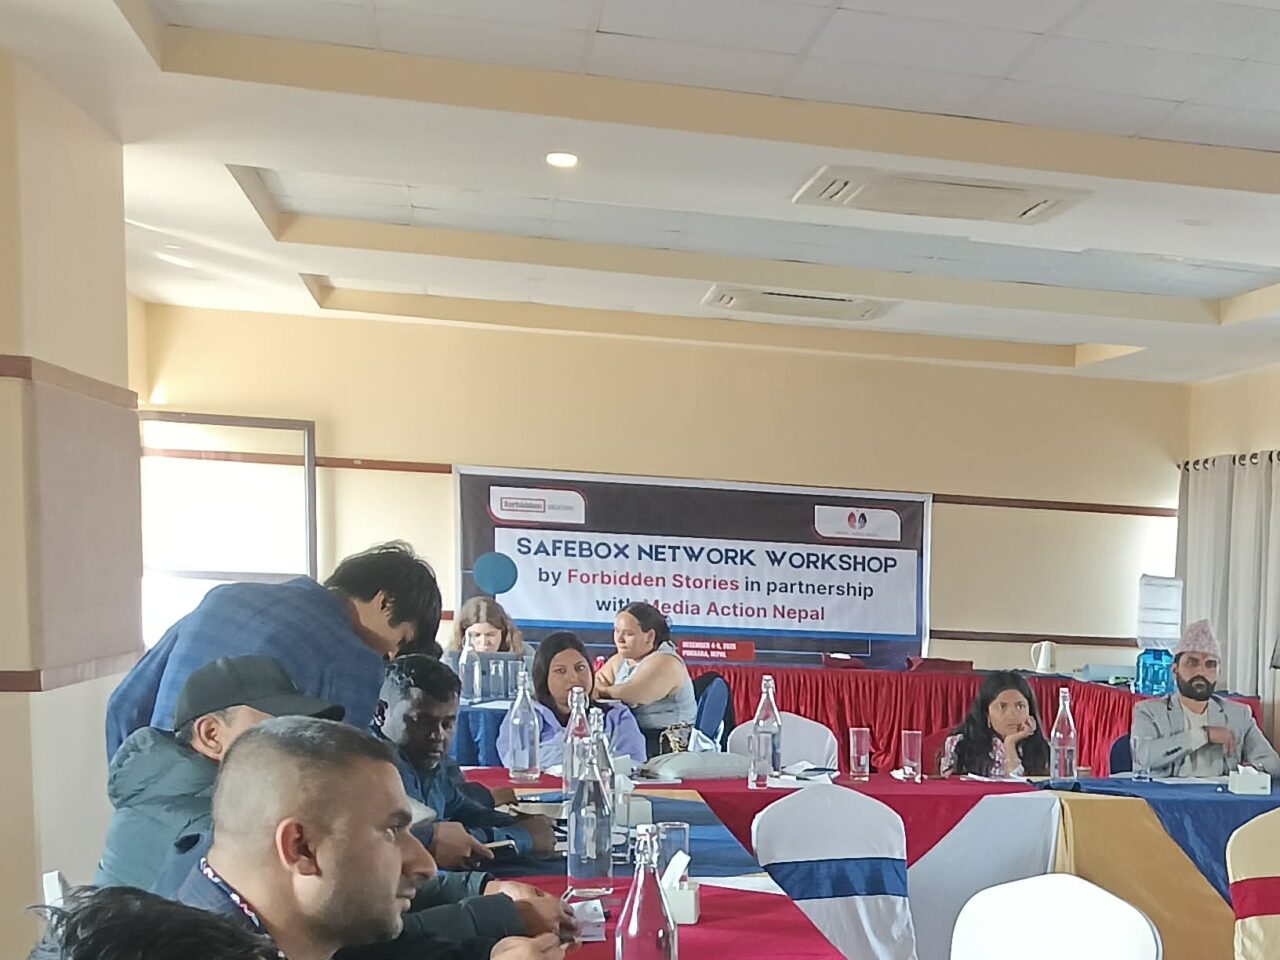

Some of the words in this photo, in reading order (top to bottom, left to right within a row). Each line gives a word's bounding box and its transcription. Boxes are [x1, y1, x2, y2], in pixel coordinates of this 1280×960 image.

[517, 537, 630, 560] SAFEBOX
[637, 544, 757, 567] NETWORK
[765, 550, 897, 574] WORKSHOP
[538, 568, 562, 587] by
[568, 568, 666, 588] Forbidden
[672, 573, 739, 591] Stories
[745, 576, 761, 592] in
[766, 579, 874, 601] partnership
[706, 601, 767, 618] Action
[773, 604, 825, 624] Nepal
